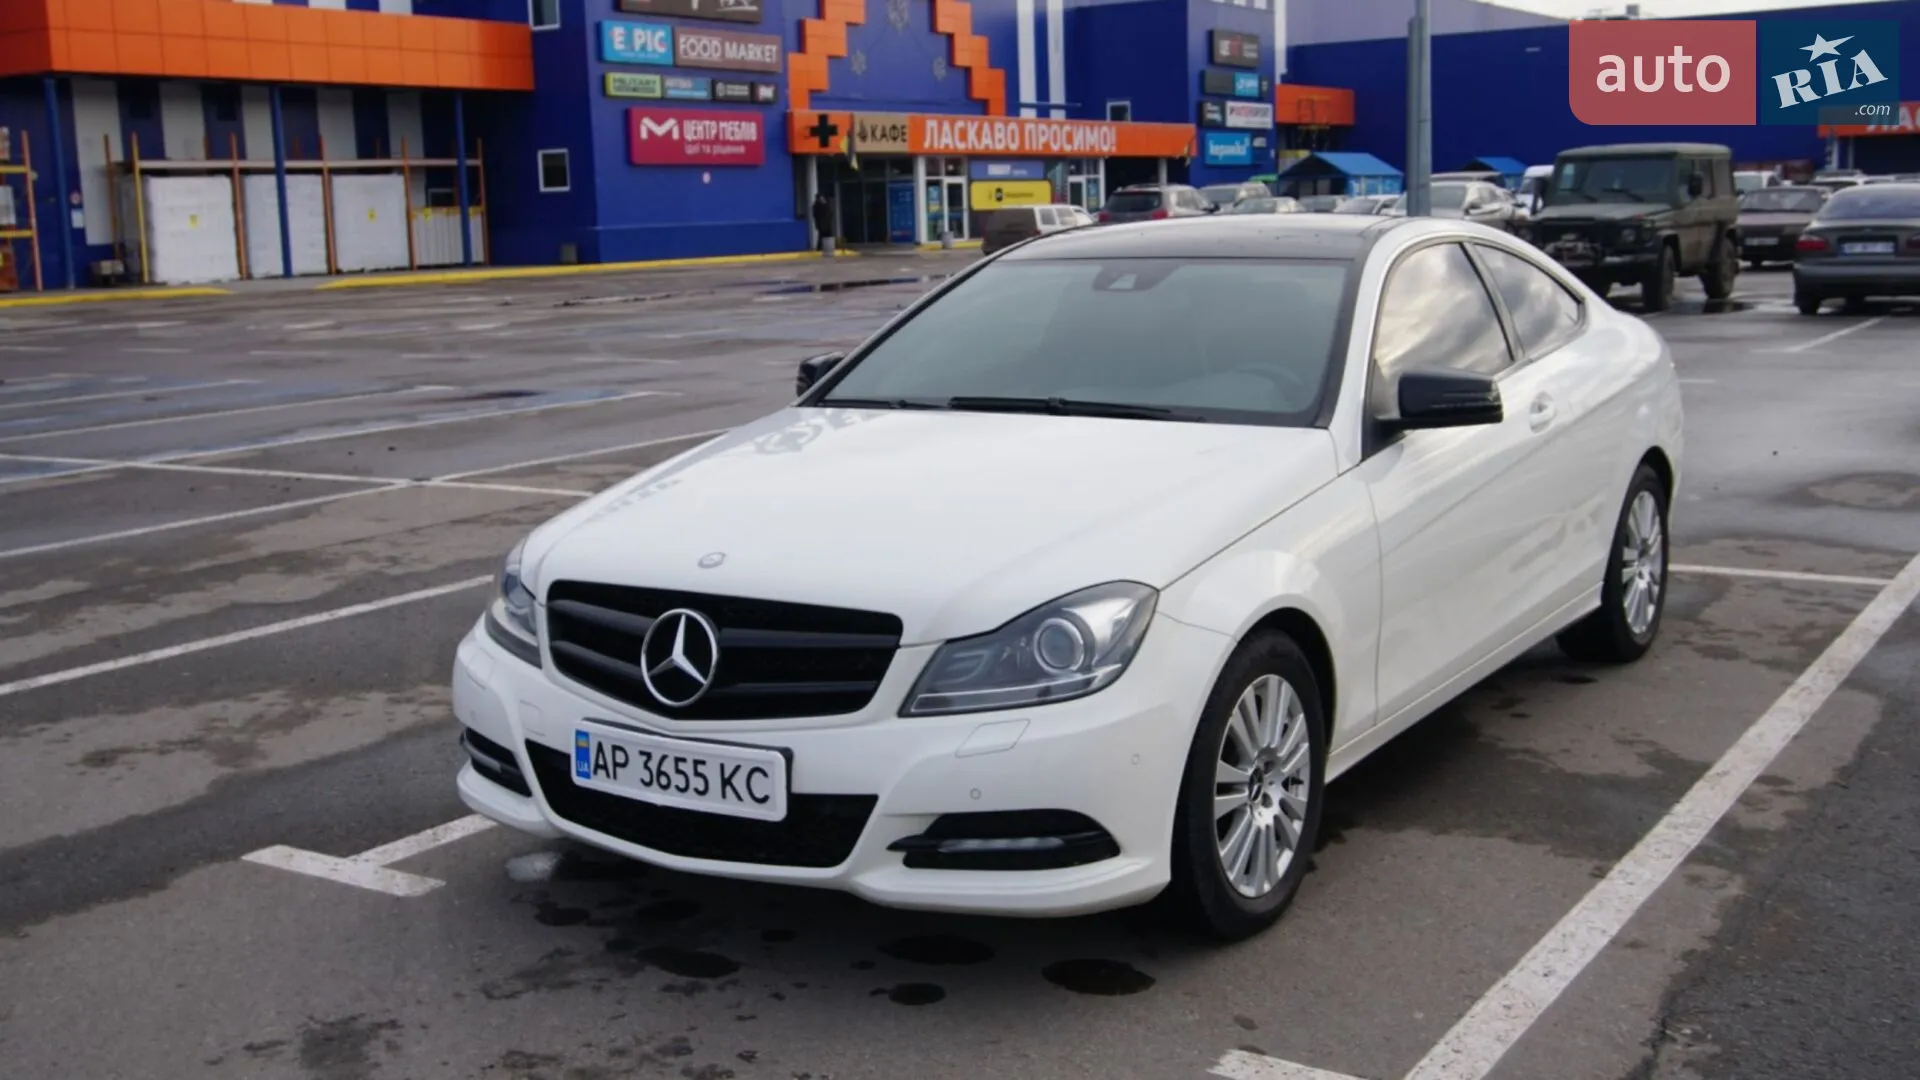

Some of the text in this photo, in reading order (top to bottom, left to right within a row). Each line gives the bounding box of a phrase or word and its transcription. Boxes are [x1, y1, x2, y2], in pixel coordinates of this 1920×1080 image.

[679, 36, 777, 63] FOOD MARKET
[683, 119, 717, 141] ЦЕНТР
[870, 124, 908, 143] КАФЕ
[924, 119, 1117, 152] ЛАСКАВО ПРОСИМО!
[577, 741, 770, 804] UA AP 3655 KC
